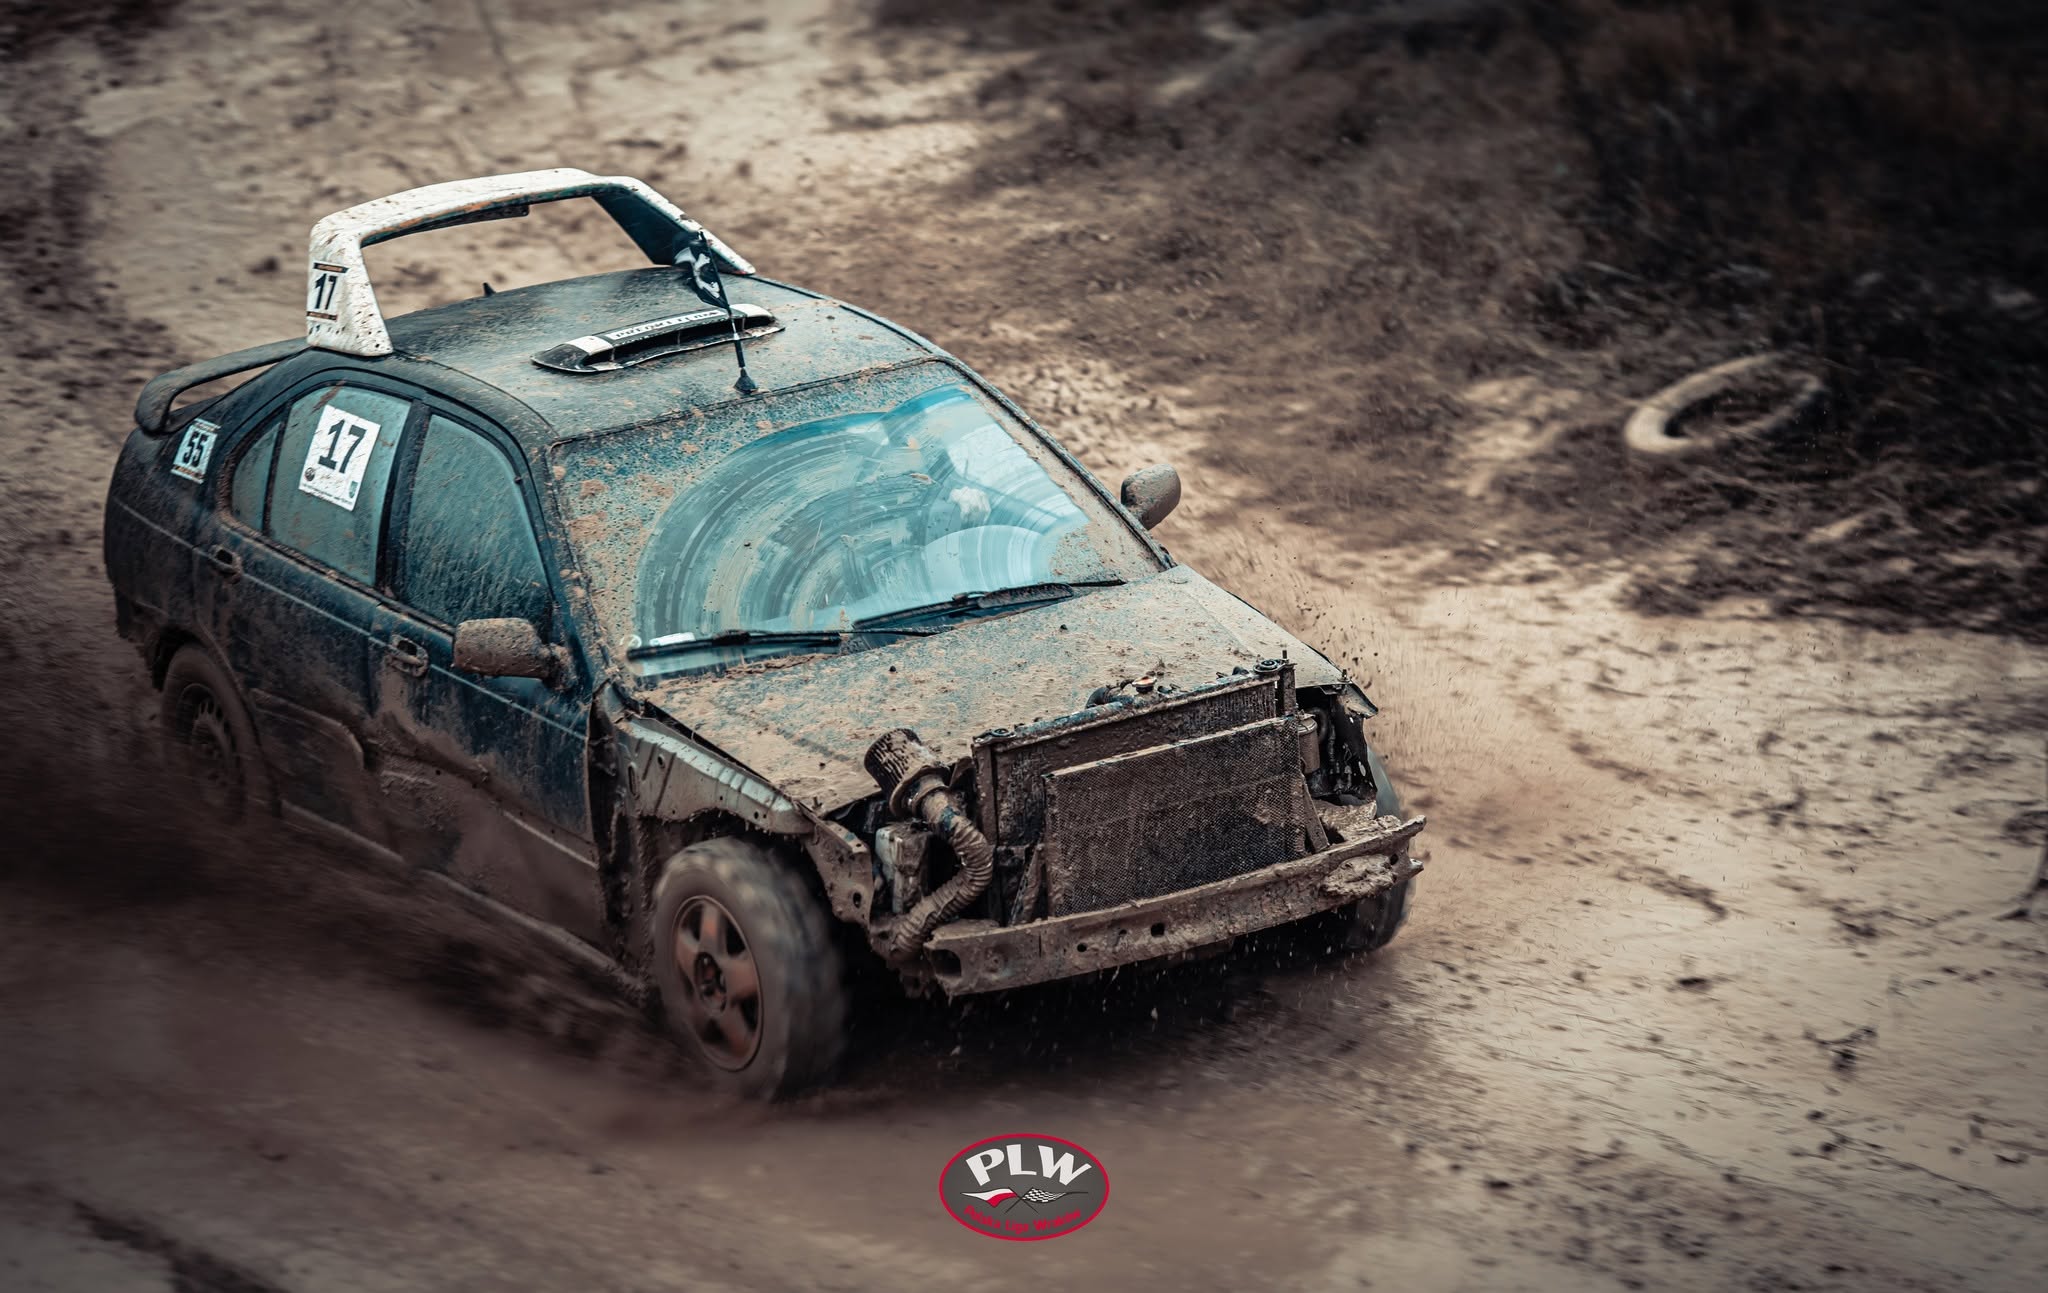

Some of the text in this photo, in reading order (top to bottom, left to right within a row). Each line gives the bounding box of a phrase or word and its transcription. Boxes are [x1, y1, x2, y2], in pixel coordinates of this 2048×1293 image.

[315, 273, 338, 310] 17
[182, 430, 209, 467] 55
[318, 419, 368, 474] 17
